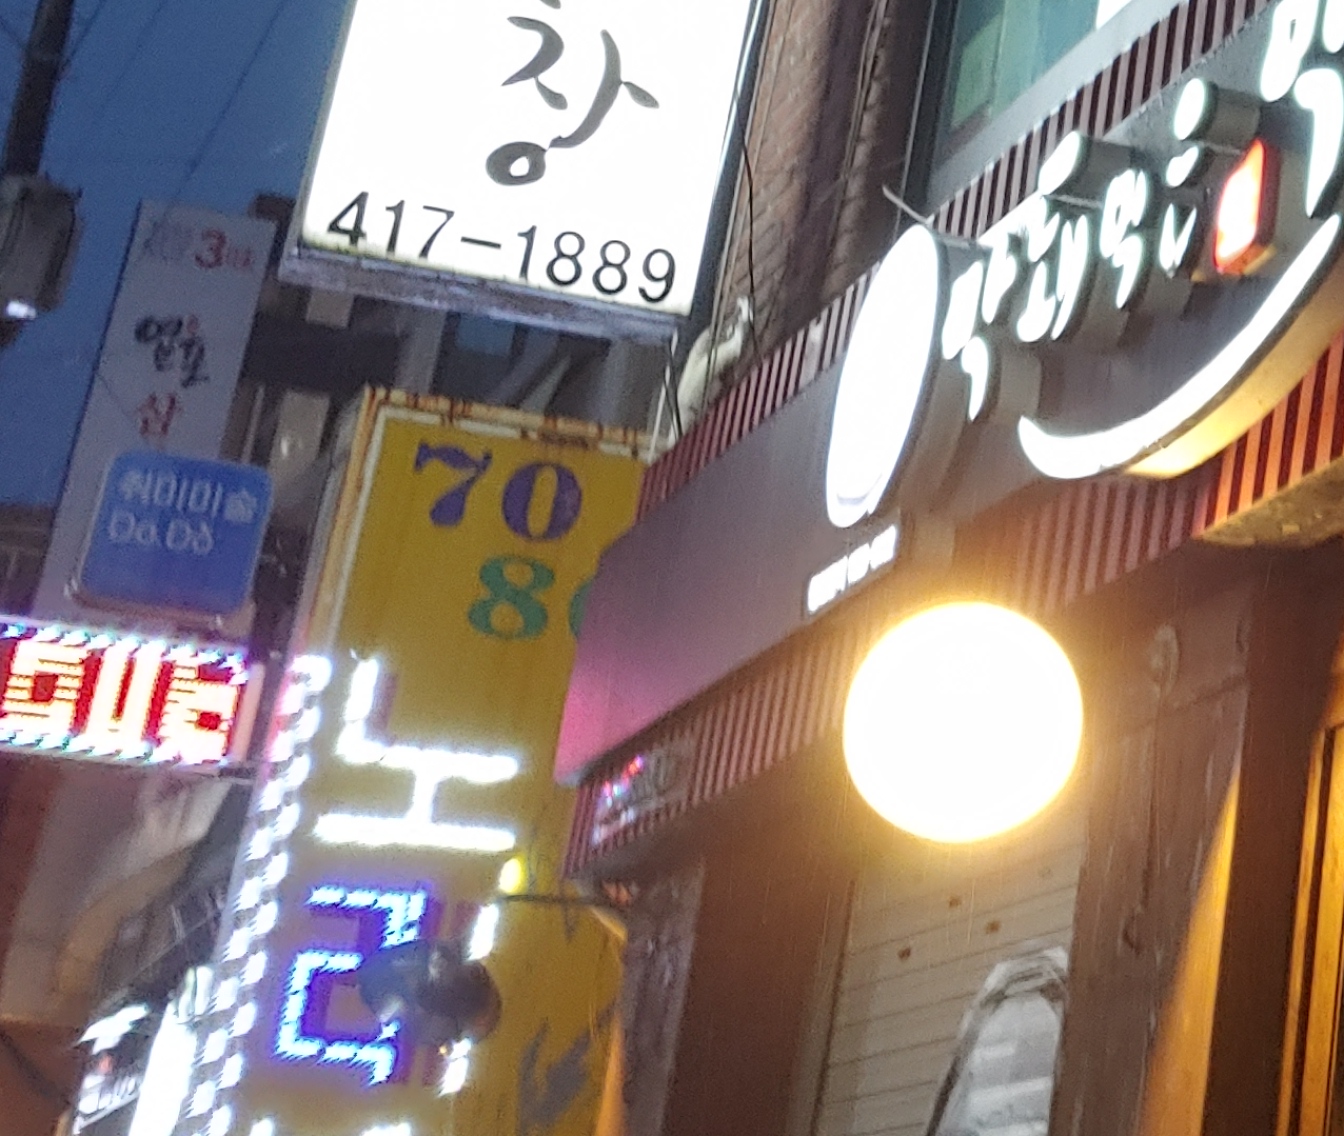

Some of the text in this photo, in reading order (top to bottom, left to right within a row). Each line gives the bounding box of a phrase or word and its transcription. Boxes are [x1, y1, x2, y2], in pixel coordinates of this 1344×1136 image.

[326, 191, 677, 305] 417-1889
[413, 439, 583, 543] 70
[467, 555, 597, 641] 8
